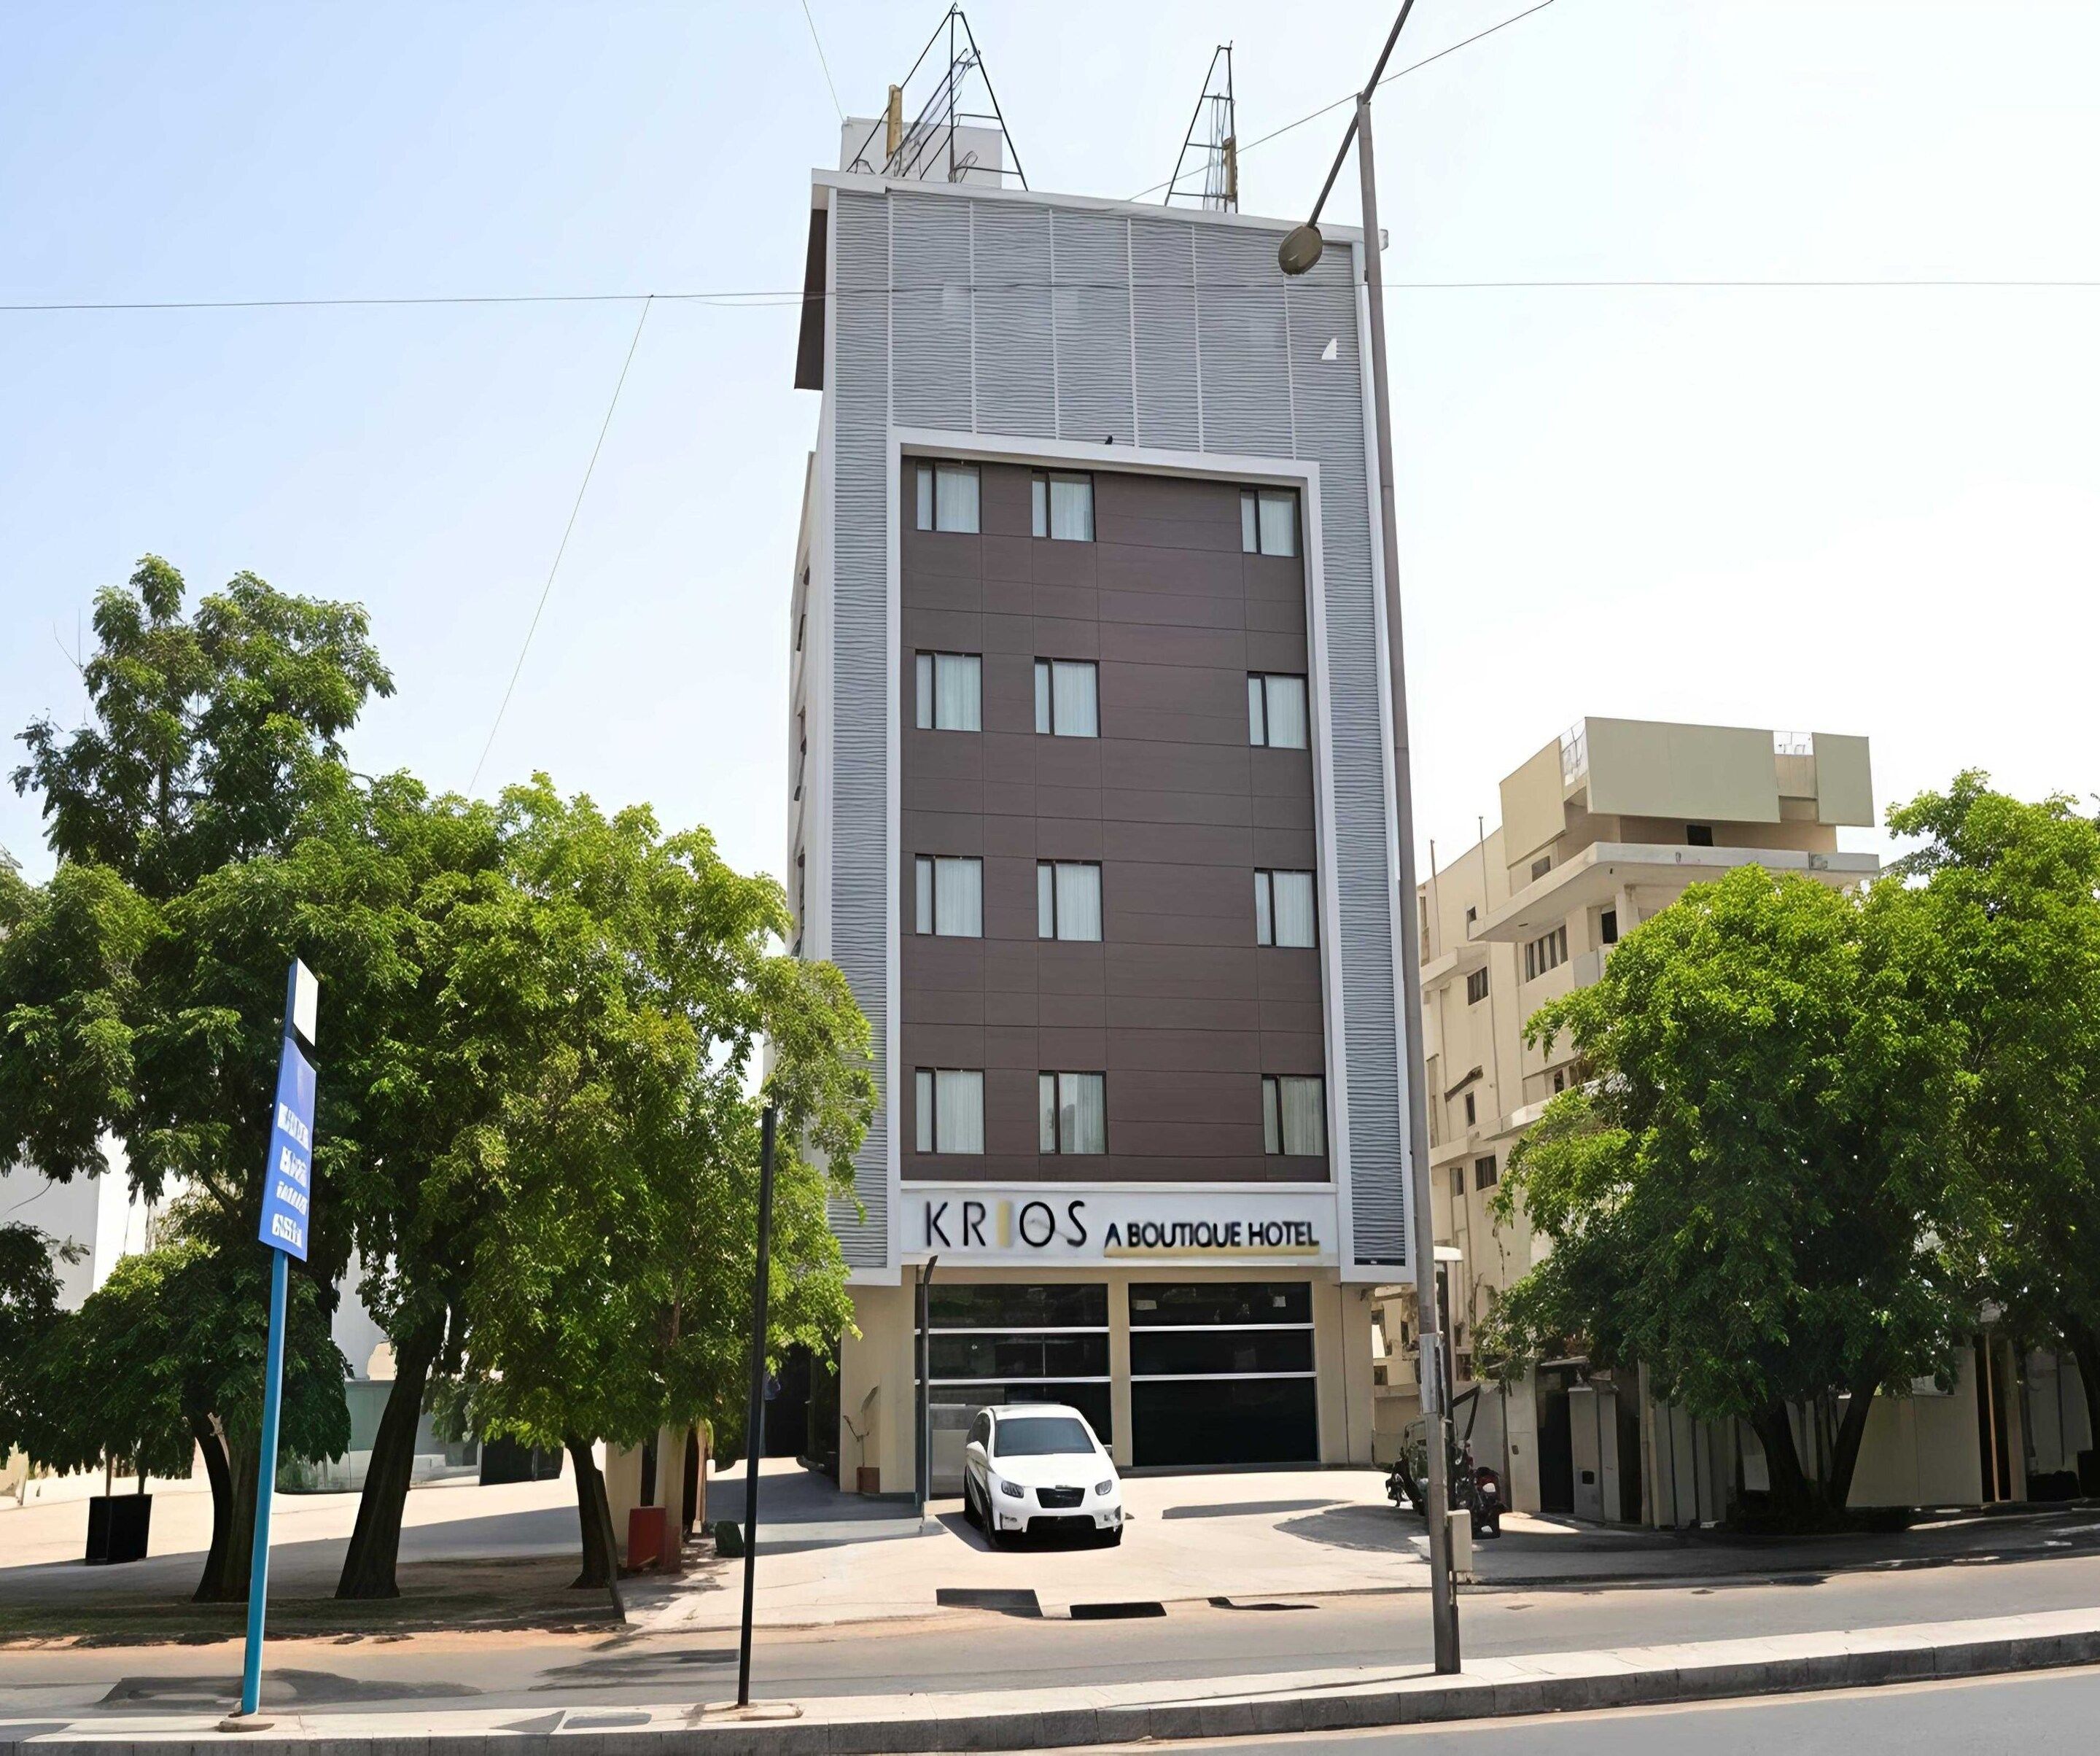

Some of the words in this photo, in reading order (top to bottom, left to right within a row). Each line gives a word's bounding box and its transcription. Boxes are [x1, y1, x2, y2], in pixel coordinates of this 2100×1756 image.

[926, 1200, 1086, 1248] KRIOS
[1104, 1222, 1121, 1247] A
[1127, 1221, 1241, 1248] BOUTIQUE
[1248, 1221, 1320, 1247] HOTEL
